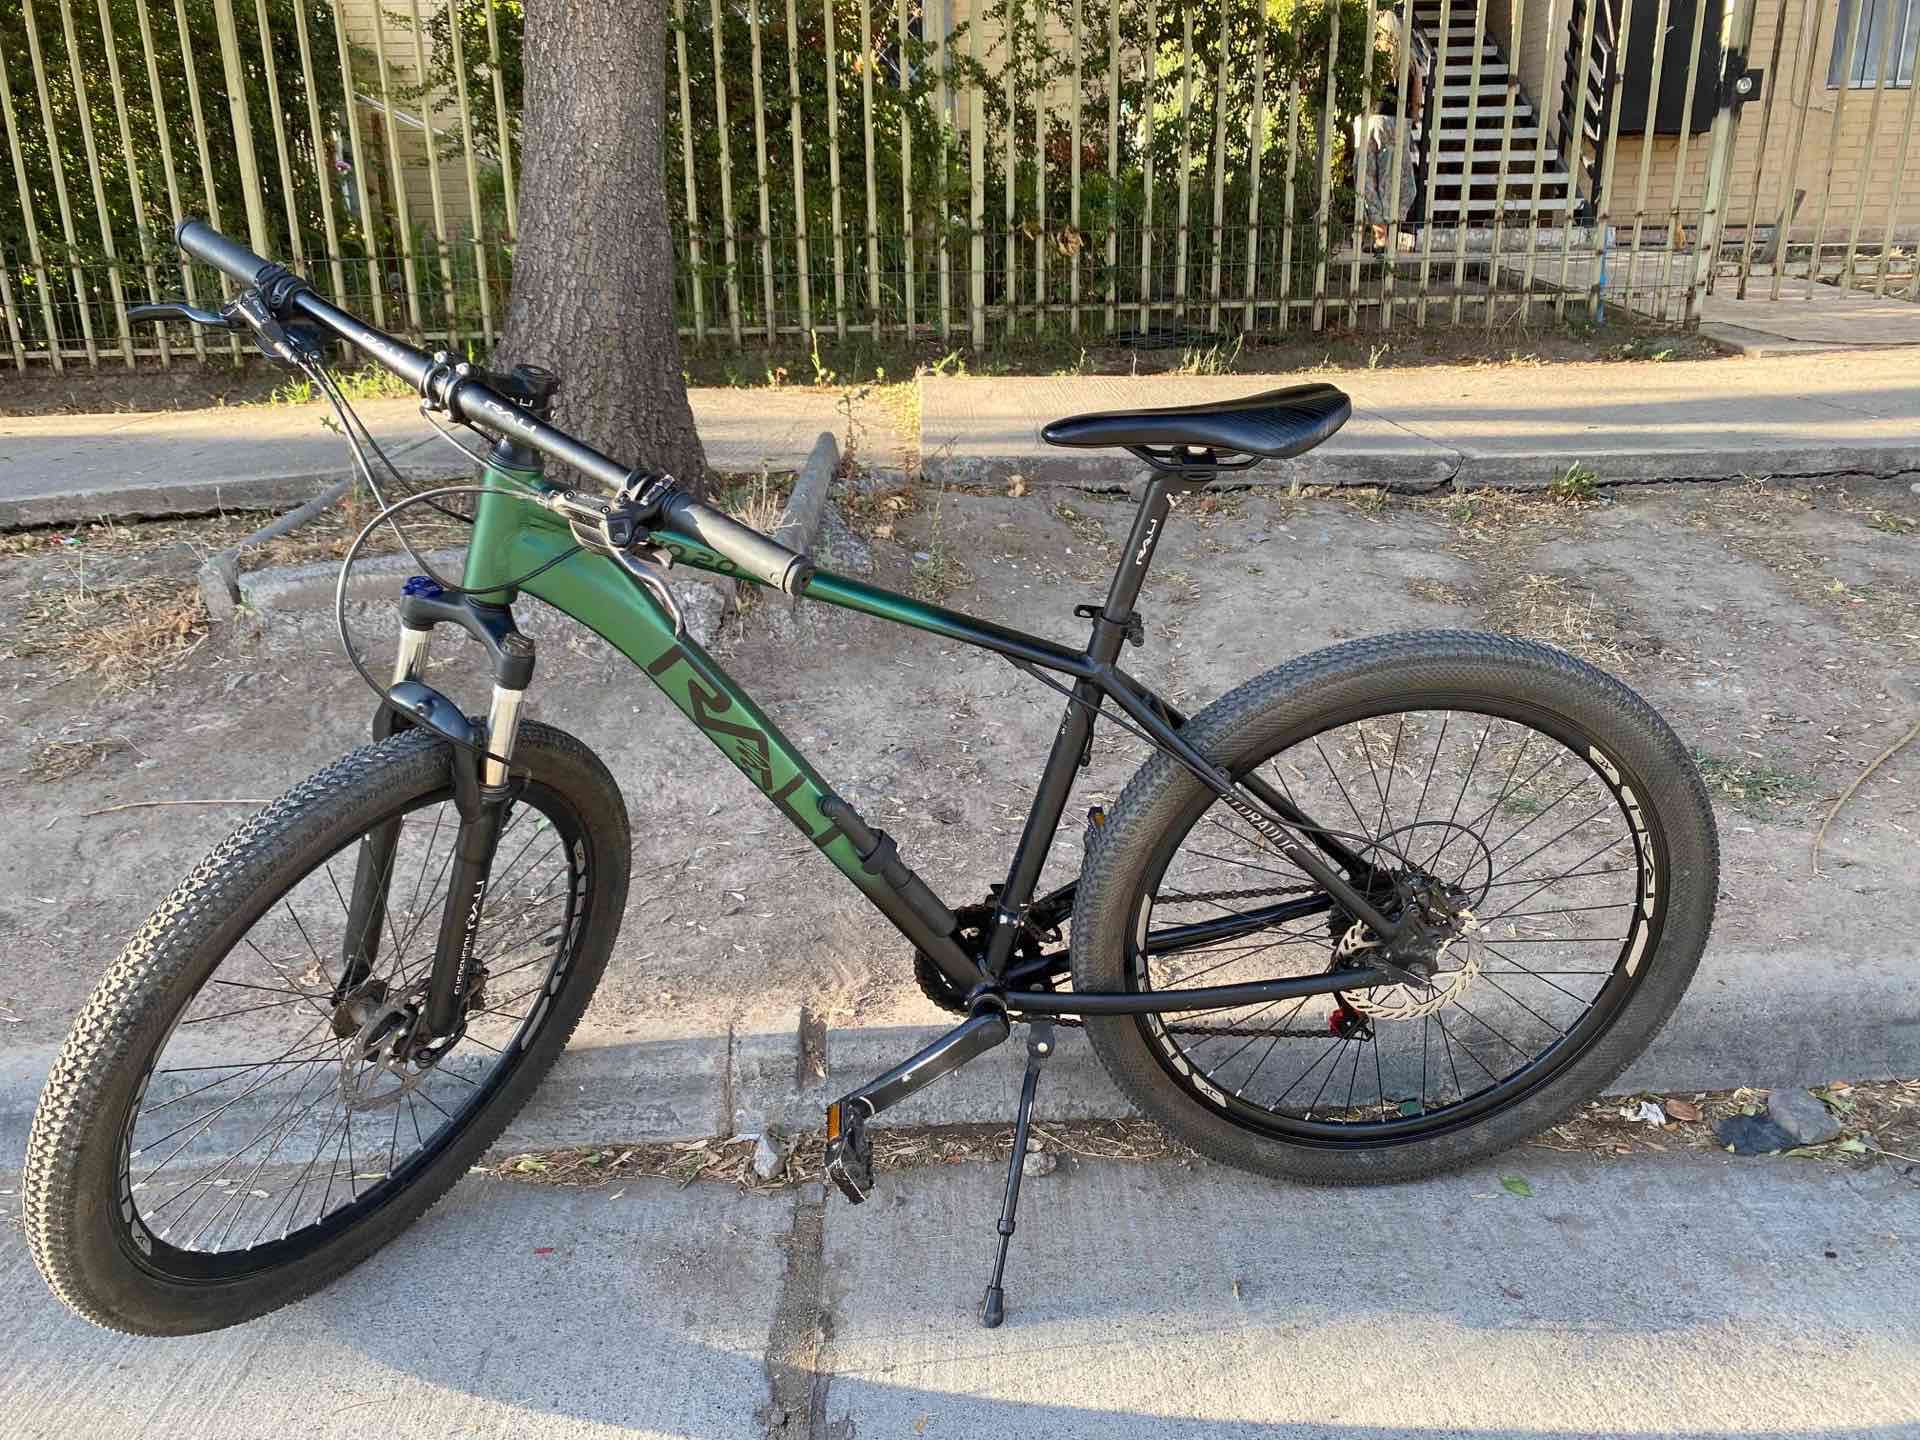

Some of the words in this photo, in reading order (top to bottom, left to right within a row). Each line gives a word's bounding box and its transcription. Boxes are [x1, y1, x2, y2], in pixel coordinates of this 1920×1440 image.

[484, 400, 537, 433] RALI
[1136, 518, 1158, 565] RALI
[647, 643, 844, 848] RALI
[1629, 804, 1656, 899] RALI
[467, 880, 486, 931] RALI
